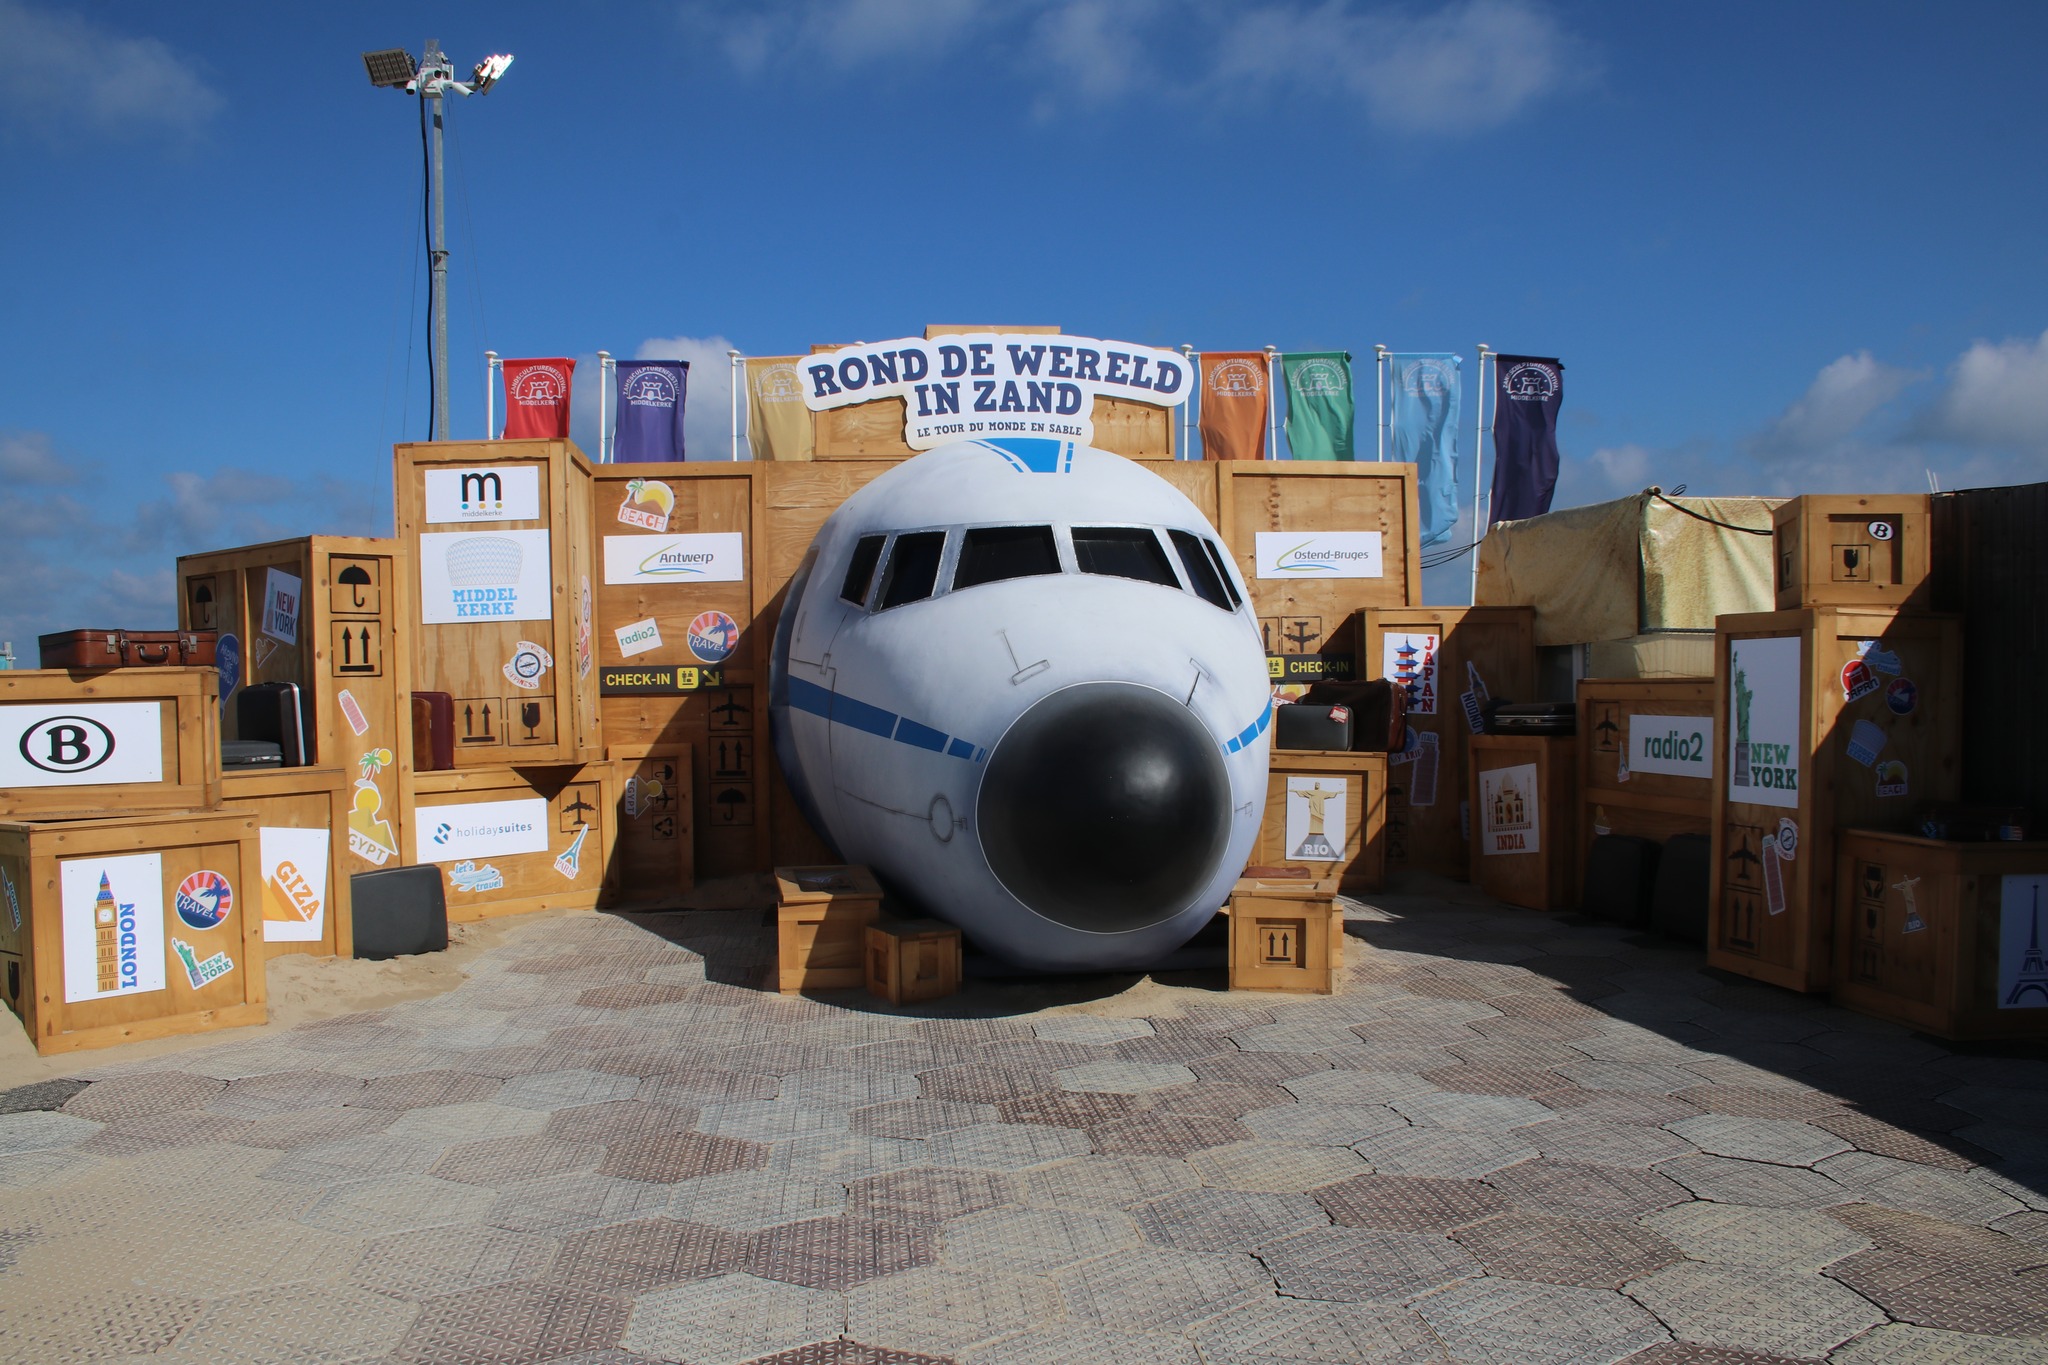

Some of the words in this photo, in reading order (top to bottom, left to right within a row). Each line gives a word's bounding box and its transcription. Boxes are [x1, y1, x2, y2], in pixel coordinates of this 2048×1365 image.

[510, 365, 566, 395] ZANDSCULPTURENFESTIVAL
[808, 348, 929, 398] ROND
[938, 343, 995, 378] DE
[1006, 344, 1183, 394] WERELD
[630, 400, 673, 408] MIDDELKERKE
[914, 381, 960, 417] IN
[973, 380, 1083, 416] ZAND
[917, 427, 931, 438] LE
[934, 424, 965, 435] TOUR
[969, 422, 984, 431] DU
[988, 421, 1026, 431] MONDE
[1030, 422, 1045, 432] EN
[1049, 423, 1083, 436] SABLE
[620, 507, 666, 530] BEACH
[1873, 524, 1889, 538] B
[659, 552, 714, 565] Antwerp
[1294, 550, 1369, 561] Ostend-Bruges
[276, 590, 296, 616] NEW
[452, 587, 518, 603] MIDDEL
[456, 602, 515, 617] KERKE
[274, 610, 296, 637] YORK
[620, 626, 656, 646] radio2
[688, 634, 726, 653] TRAVEL
[1290, 661, 1349, 673] CHECK-IN
[1421, 636, 1435, 713] JAPAN
[606, 673, 671, 686] CHECK-IN
[46, 724, 91, 765] B
[1644, 730, 1703, 762] radio2
[1751, 743, 1790, 766] NEW
[1751, 766, 1797, 790] YORK
[627, 781, 635, 812] EGYPT
[456, 822, 533, 837] holidaysuites
[348, 832, 386, 862] GYPT
[1303, 844, 1329, 856] RIO
[1496, 833, 1526, 851] INDIA
[455, 861, 474, 874] let's
[555, 859, 576, 879] PARIS
[275, 860, 321, 921] GIZA
[475, 878, 502, 891] travel
[176, 892, 215, 920] TRAVEL
[119, 903, 138, 989] LONDON
[199, 955, 223, 974] NEW
[202, 960, 232, 981] YORK
